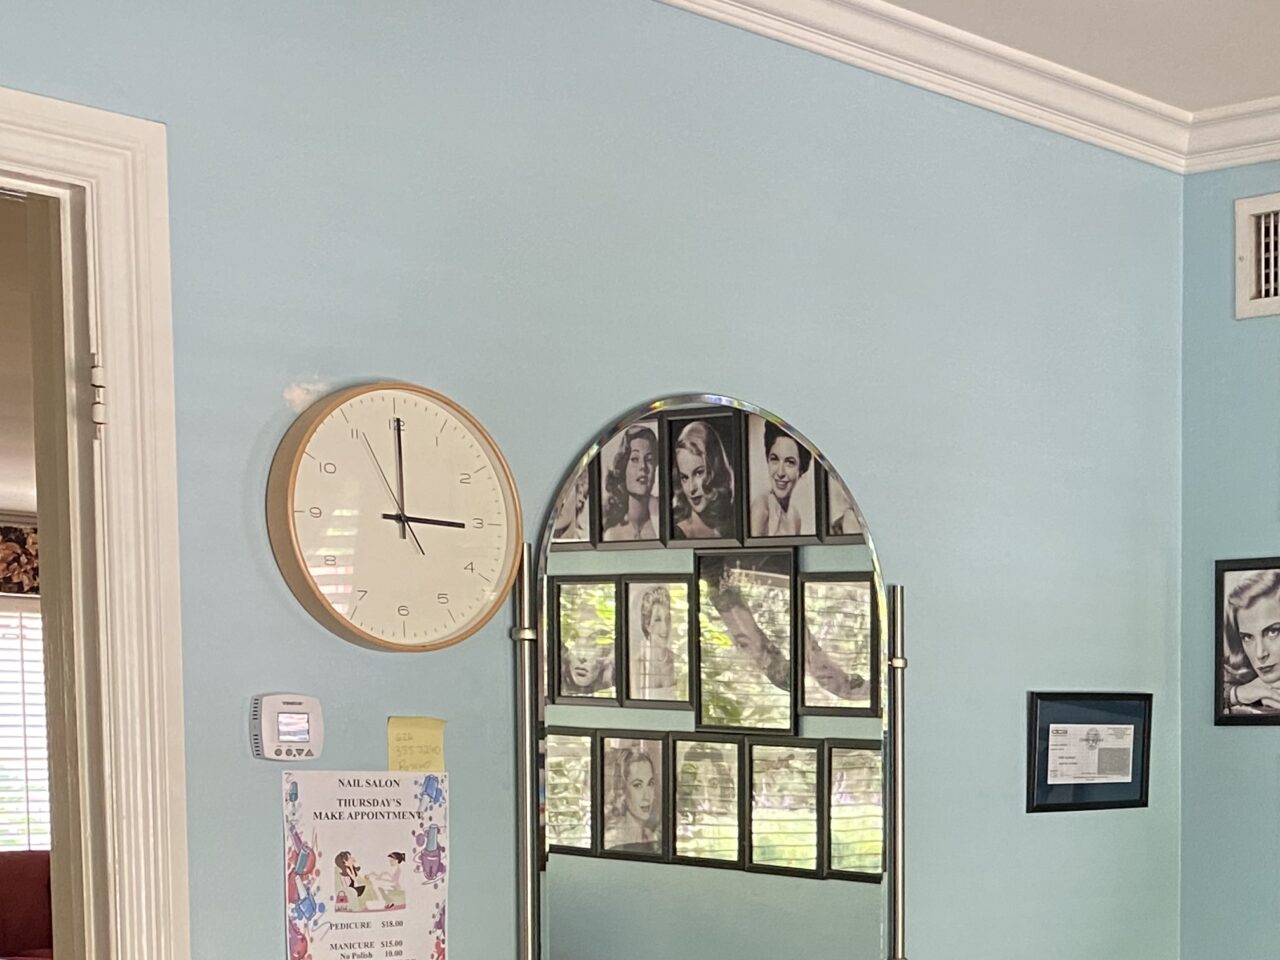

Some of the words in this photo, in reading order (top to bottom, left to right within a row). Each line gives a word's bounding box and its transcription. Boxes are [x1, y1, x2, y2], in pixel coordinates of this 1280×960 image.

[388, 418, 406, 432] 12
[351, 428, 359, 440] 11
[319, 461, 337, 475] 10
[459, 472, 472, 485] 2
[309, 506, 323, 519] 9
[472, 517, 485, 530] 3
[323, 554, 337, 567] 8
[463, 561, 476, 573] 4
[356, 590, 369, 601] 7
[436, 593, 450, 605] 5
[397, 605, 410, 617] 6
[338, 778, 363, 788] NAIL
[365, 778, 400, 788] SALON
[336, 798, 402, 808] THURSDAY'S
[313, 811, 345, 820] MAKE
[347, 810, 424, 820] APPOINTMENT
[329, 921, 372, 930] PEDICURE
[381, 920, 404, 929] $18.00
[329, 941, 375, 951] MANICURE
[380, 940, 403, 948] $15.00
[351, 951, 373, 960] Polish
